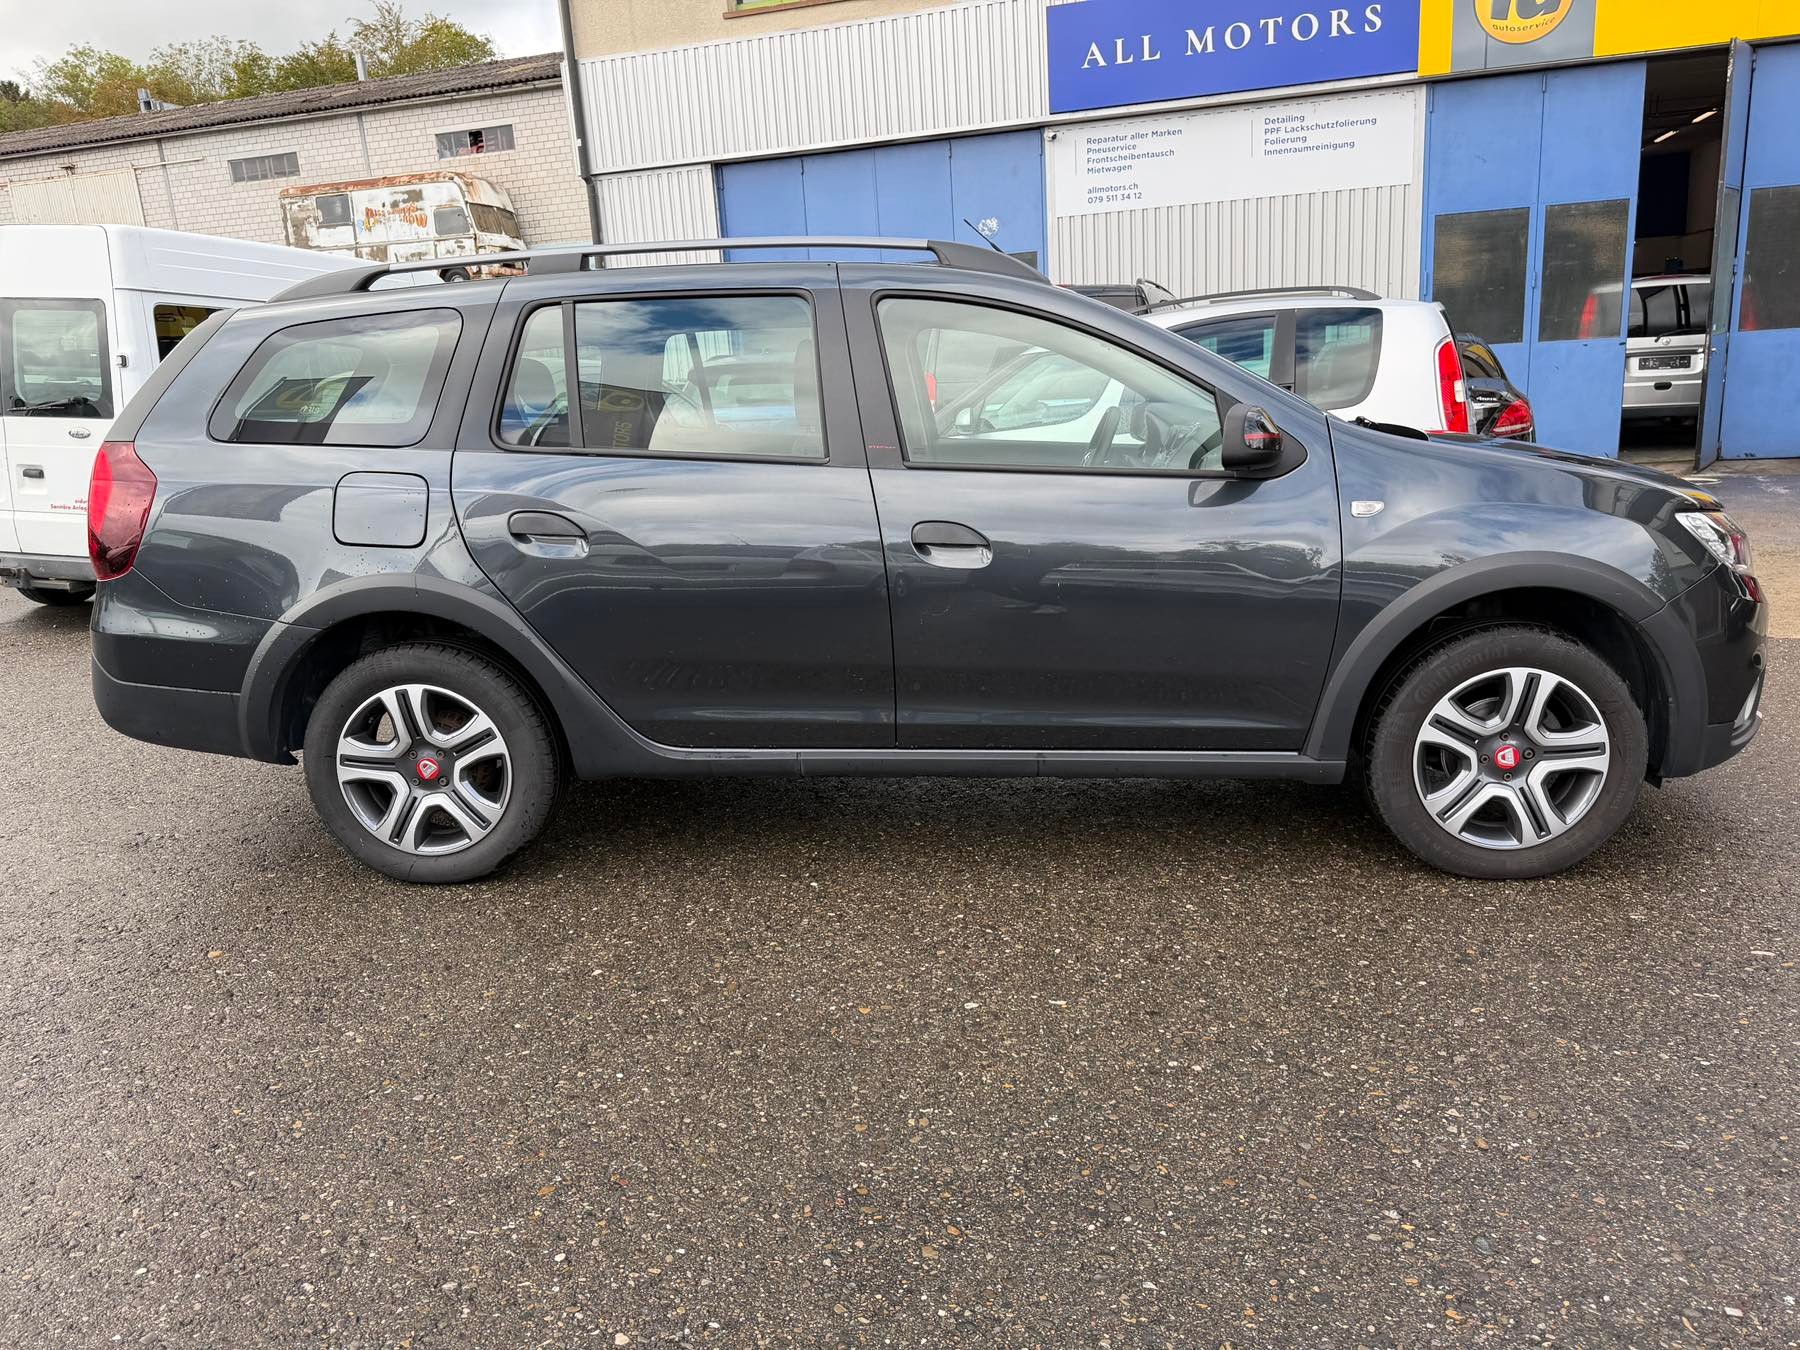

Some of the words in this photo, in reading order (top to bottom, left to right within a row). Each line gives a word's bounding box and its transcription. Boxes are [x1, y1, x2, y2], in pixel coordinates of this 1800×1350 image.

[1492, 16, 1556, 32] autoservice
[1081, 34, 1161, 69] ALL
[1184, 4, 1383, 56] MOTORS
[1264, 114, 1305, 125] Detailing
[1264, 126, 1282, 135] PPF
[1284, 117, 1377, 133] Lackschutzfolierung
[1086, 134, 1128, 145] Reparatur
[1130, 132, 1149, 140] aller
[1151, 128, 1183, 138] Marken
[1264, 135, 1307, 146] Folierung
[1086, 143, 1137, 155] Pneuservice
[1264, 140, 1355, 156] Innenraumreinigung
[1087, 149, 1175, 164] Frontscheibentausch
[1087, 163, 1133, 175] Mietwagen
[1087, 182, 1139, 194] allmotors.ch
[1087, 195, 1103, 204] 079
[1106, 194, 1118, 202] 511
[1120, 193, 1131, 201] 34
[1133, 191, 1143, 200] 12
